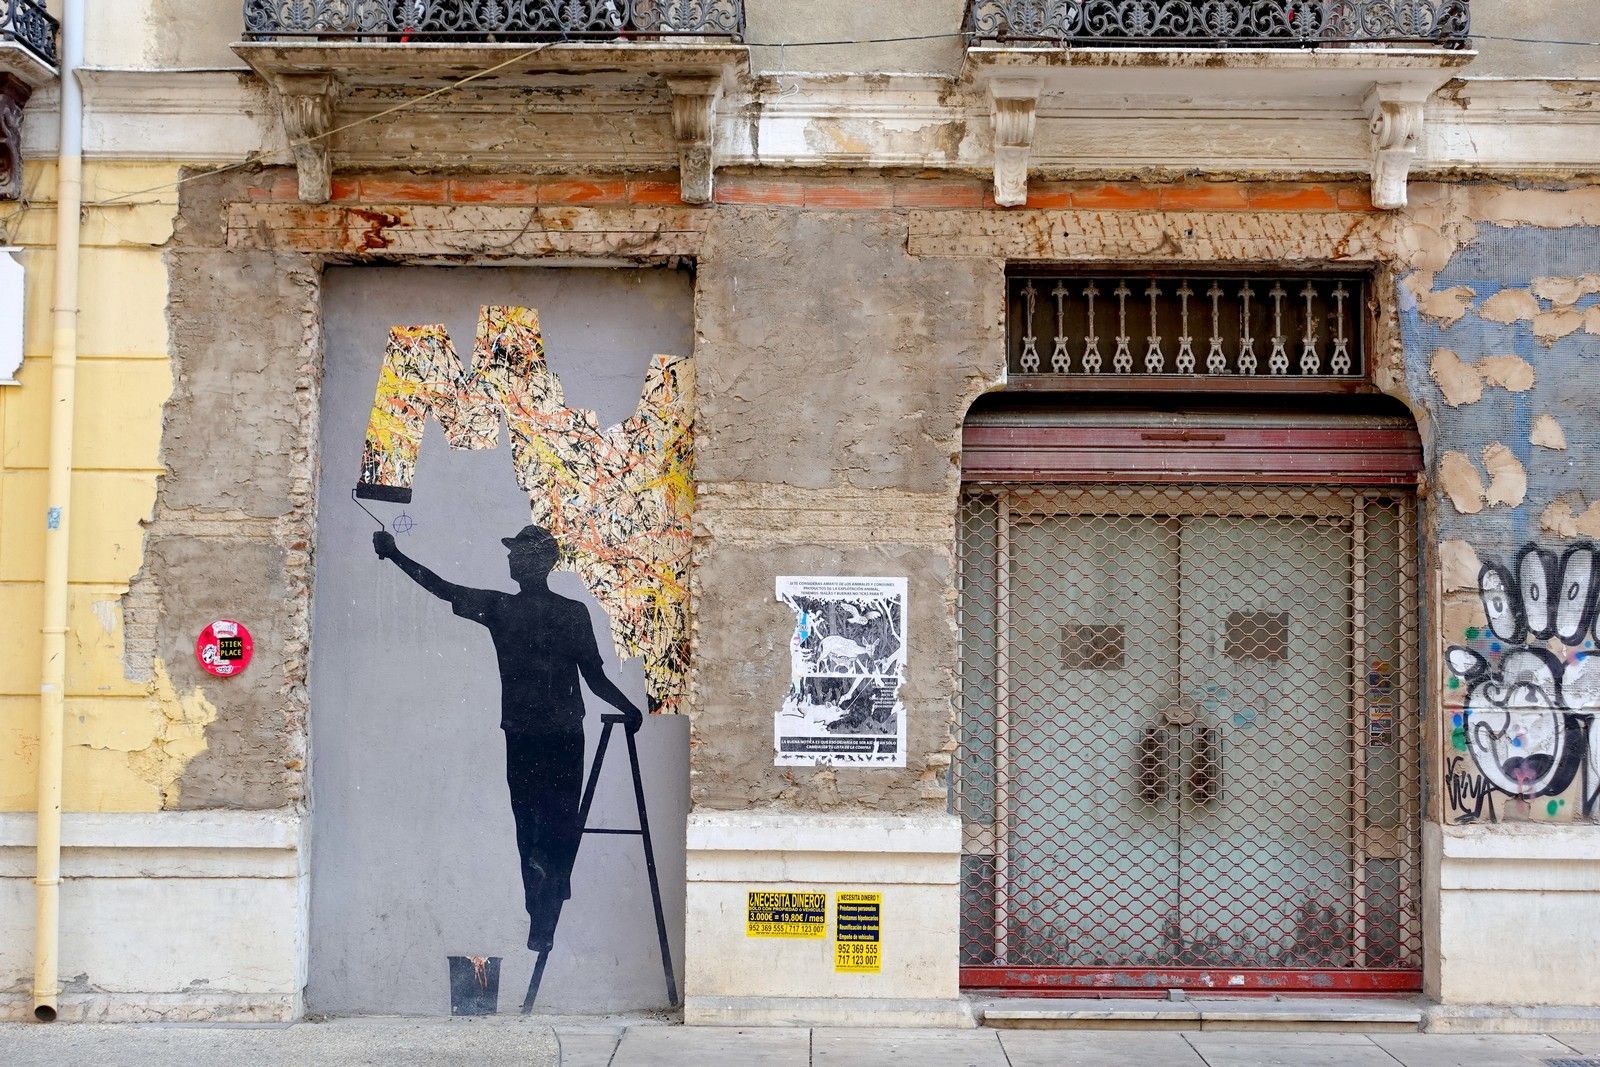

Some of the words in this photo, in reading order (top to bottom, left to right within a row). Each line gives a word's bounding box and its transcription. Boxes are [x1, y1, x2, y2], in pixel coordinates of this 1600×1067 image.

[749, 893, 790, 907] ¿NECESITA
[792, 894, 825, 908] DINERO?
[750, 912, 773, 922] 3.000€
[838, 944, 850, 954] 952
[852, 944, 864, 954] 369
[866, 944, 878, 954] 555
[838, 955, 850, 964] 717
[852, 955, 864, 964] 123
[865, 955, 878, 964] 007
